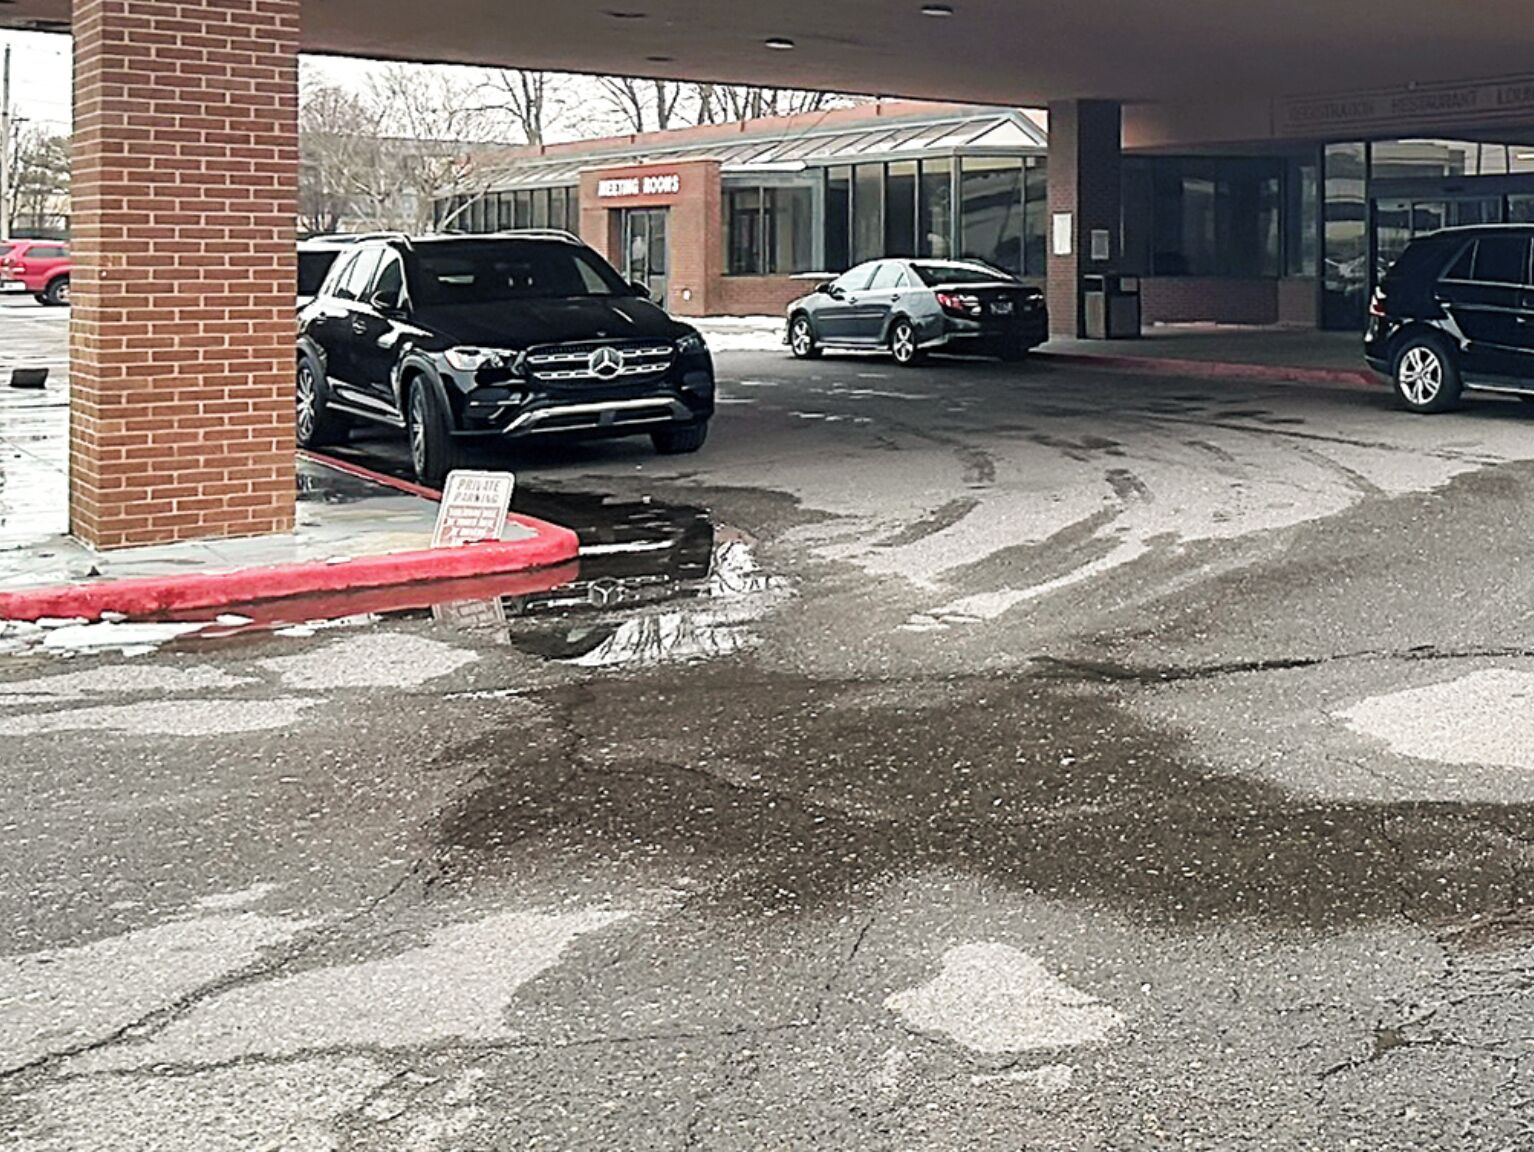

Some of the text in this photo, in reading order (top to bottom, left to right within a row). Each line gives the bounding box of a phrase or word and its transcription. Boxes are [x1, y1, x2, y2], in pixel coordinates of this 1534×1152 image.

[1391, 89, 1477, 113] RESTAURANT
[598, 174, 680, 197] MEETING ROOMS
[457, 478, 501, 491] PRIVATE
